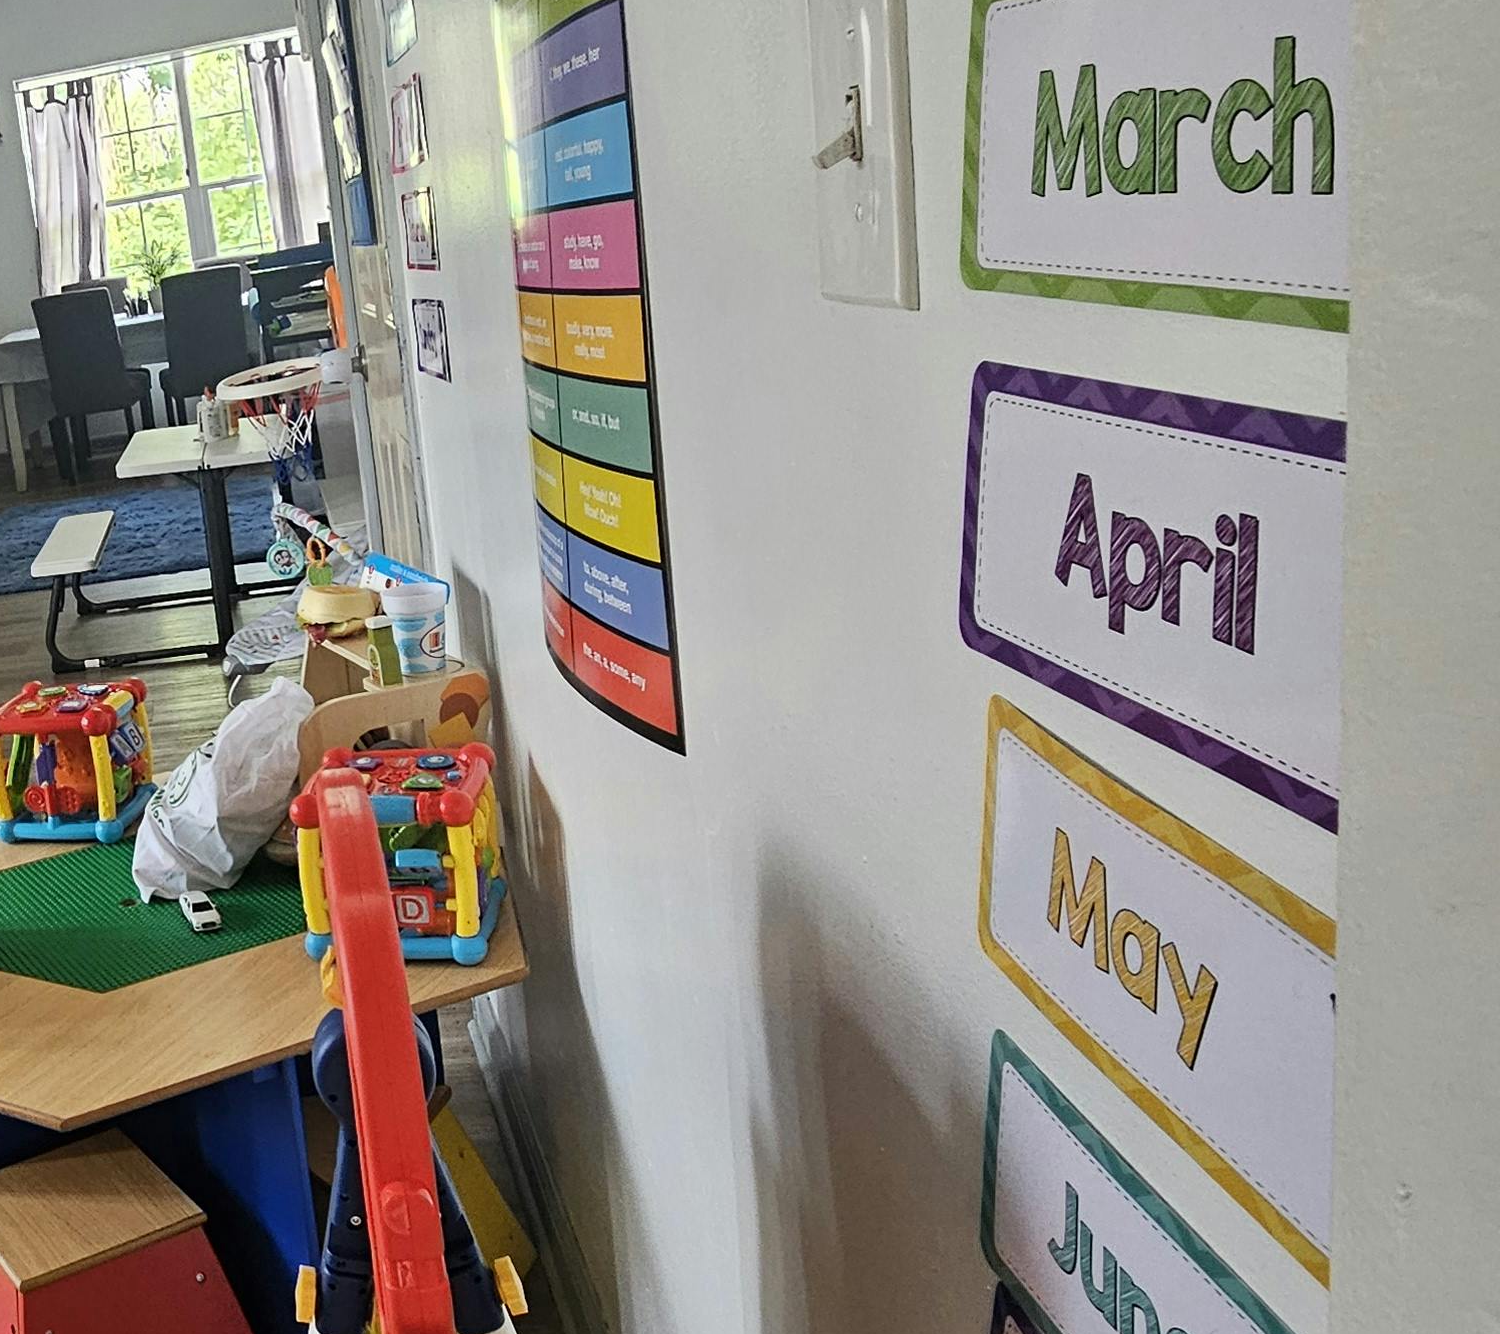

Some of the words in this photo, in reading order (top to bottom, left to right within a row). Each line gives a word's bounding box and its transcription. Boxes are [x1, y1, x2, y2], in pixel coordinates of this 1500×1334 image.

[588, 46, 601, 63] her
[1030, 35, 1334, 197] March
[592, 234, 605, 251] go,
[1054, 472, 1261, 656] April
[631, 672, 647, 692] any
[400, 896, 424, 921] D
[1046, 825, 1219, 1072] May
